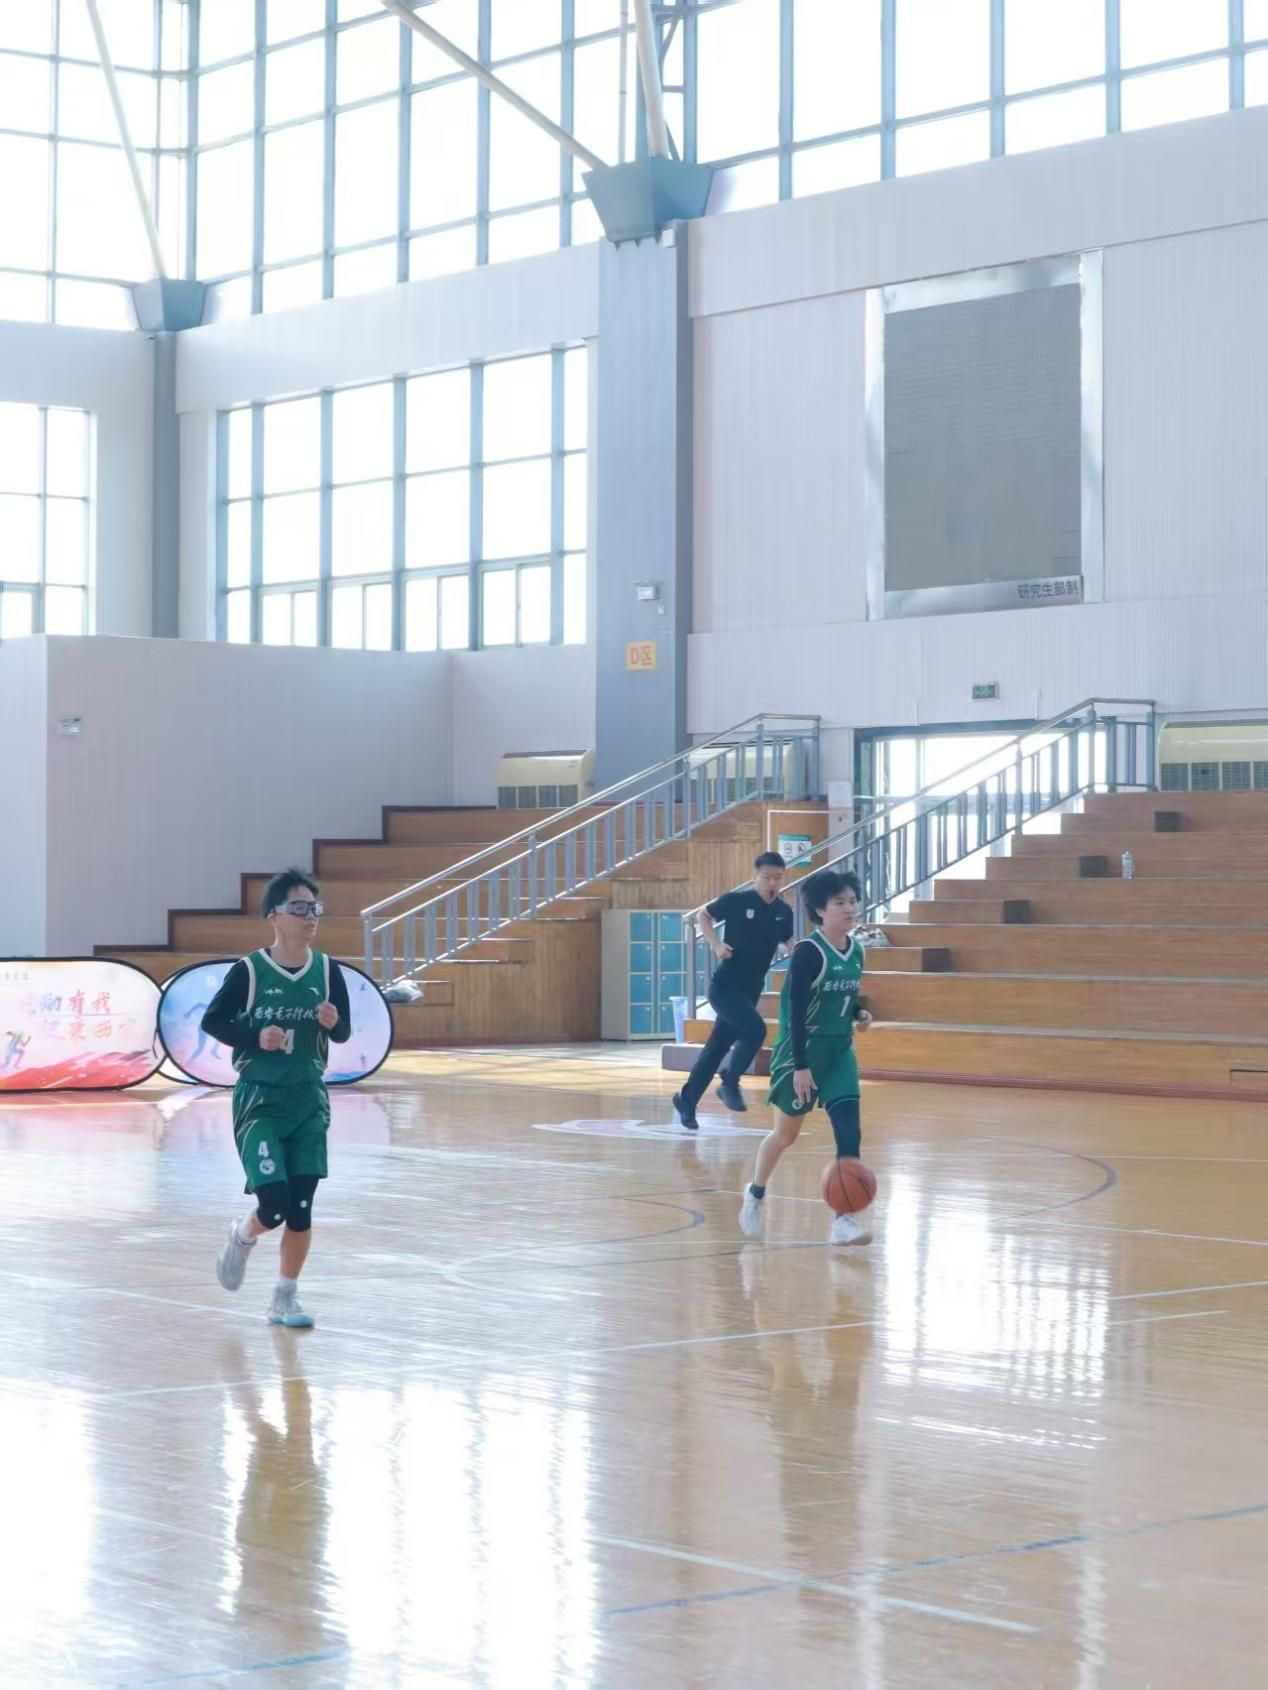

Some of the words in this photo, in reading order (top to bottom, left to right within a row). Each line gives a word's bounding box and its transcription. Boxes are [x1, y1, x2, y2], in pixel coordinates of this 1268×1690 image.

[630, 645, 654, 667] D区
[840, 996, 851, 1017] 1
[280, 1028, 295, 1055] 4
[257, 1141, 269, 1158] 4
